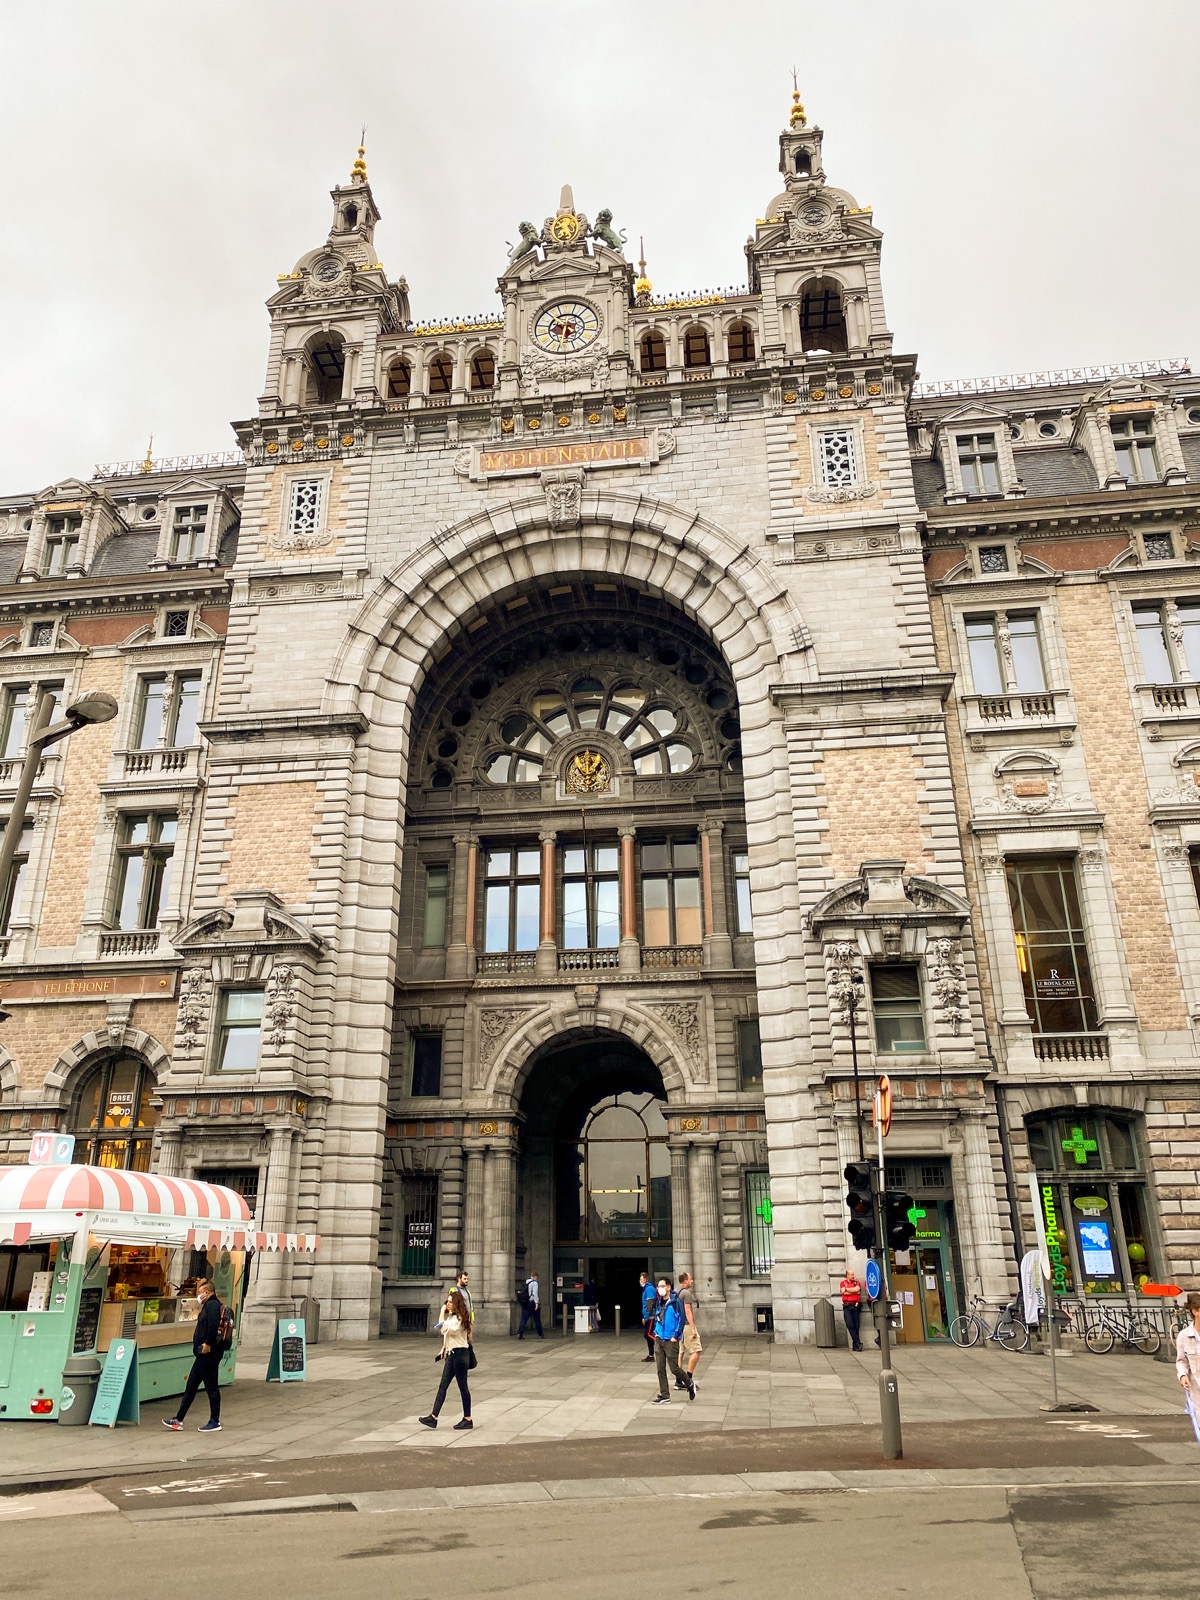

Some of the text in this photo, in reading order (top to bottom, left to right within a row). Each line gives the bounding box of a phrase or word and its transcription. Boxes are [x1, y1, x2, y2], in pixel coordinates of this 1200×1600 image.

[1050, 968, 1060, 979] R
[44, 981, 111, 994] TELEPHONE
[108, 1106, 131, 1117] sop
[409, 1236, 431, 1249] shop
[1042, 1186, 1068, 1295] LloydsPharma
[888, 1382, 895, 1393] 3
